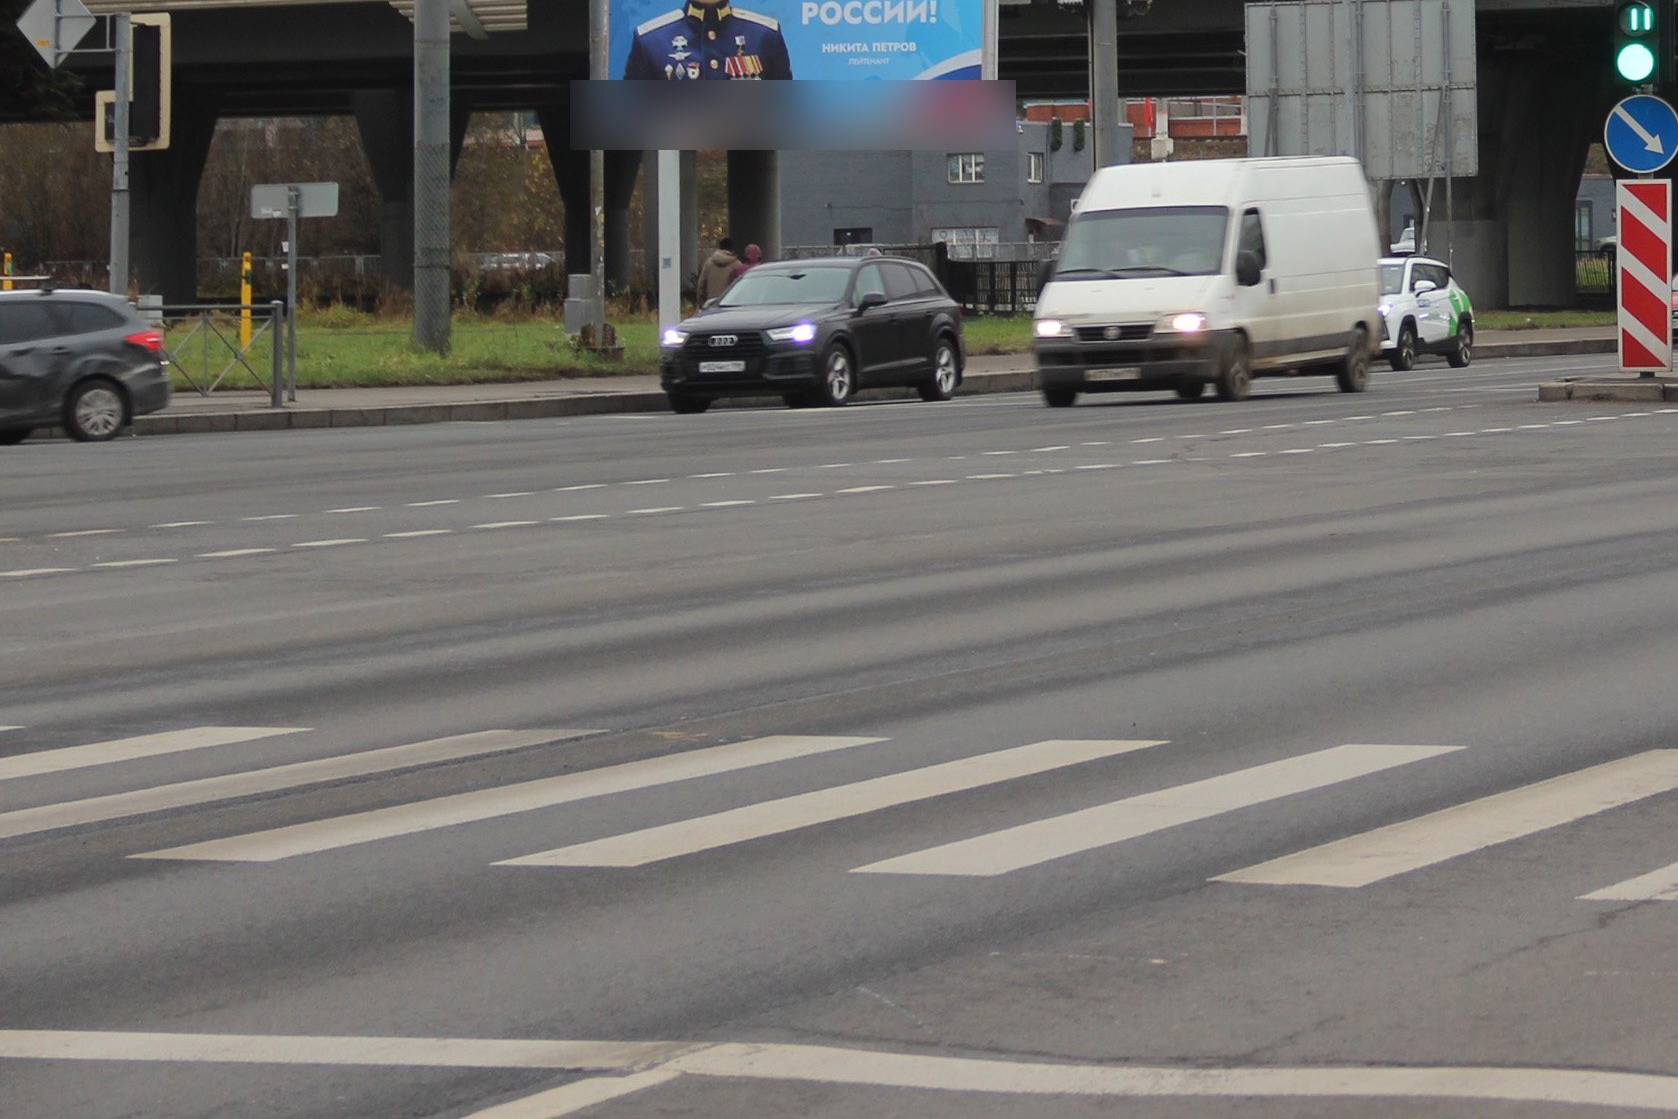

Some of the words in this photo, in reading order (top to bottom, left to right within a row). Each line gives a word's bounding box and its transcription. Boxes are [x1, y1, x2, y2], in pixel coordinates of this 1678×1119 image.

[801, 0, 937, 25] РОССИИ!
[822, 42, 869, 53] НИКИТА
[872, 41, 917, 52] ПЕТРОВ
